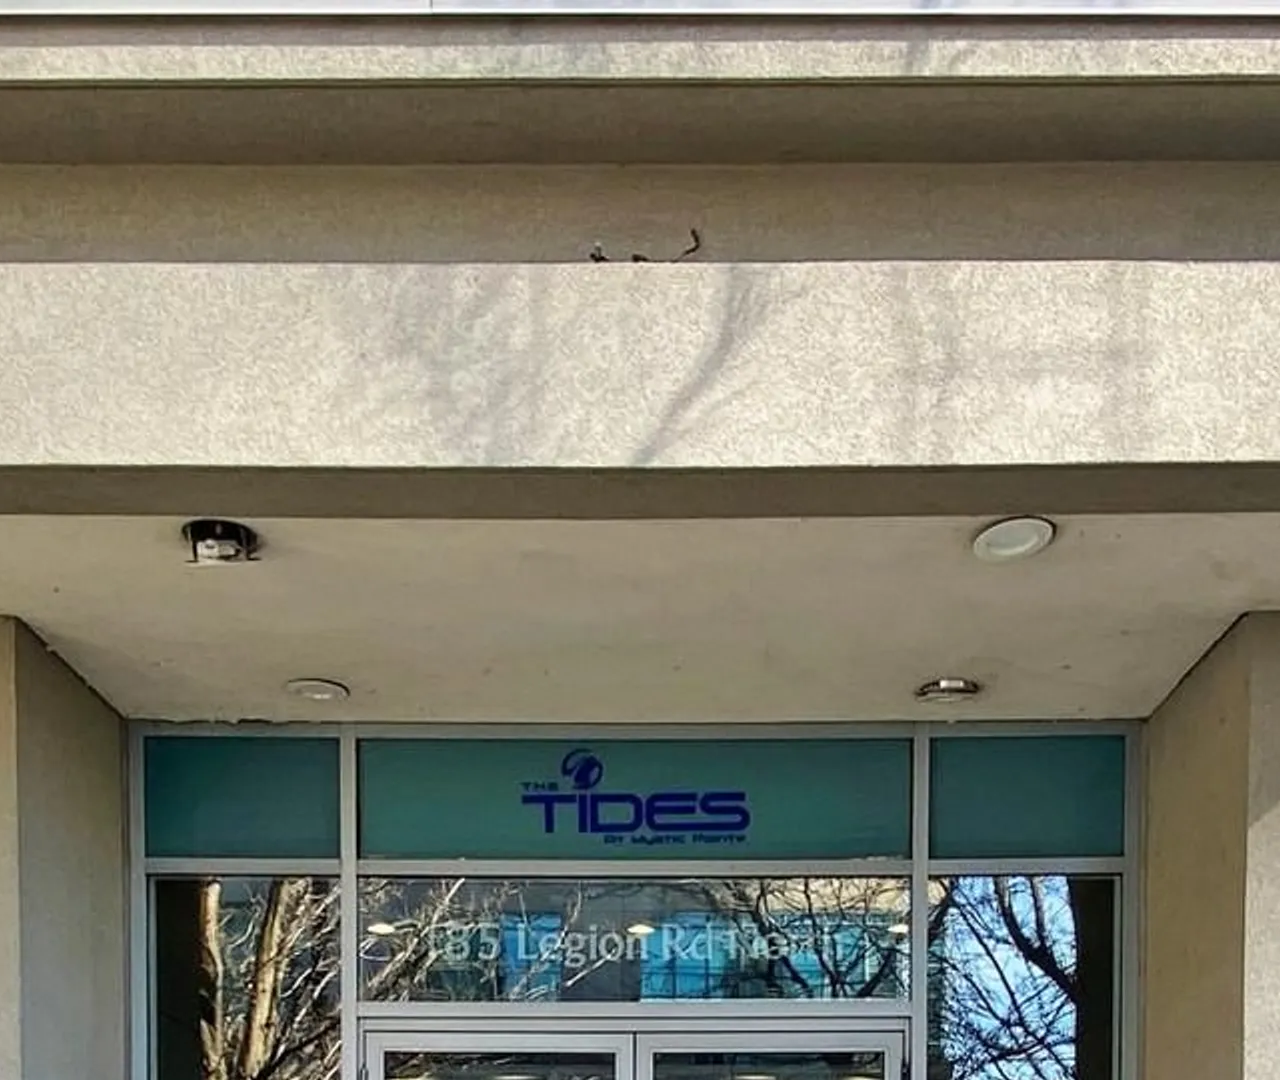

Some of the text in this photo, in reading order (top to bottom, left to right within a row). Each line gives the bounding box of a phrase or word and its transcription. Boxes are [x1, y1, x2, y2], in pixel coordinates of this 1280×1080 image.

[521, 781, 559, 791] THE
[522, 792, 750, 833] TIDES
[517, 922, 648, 969] Legion
[662, 922, 713, 961] Rd
